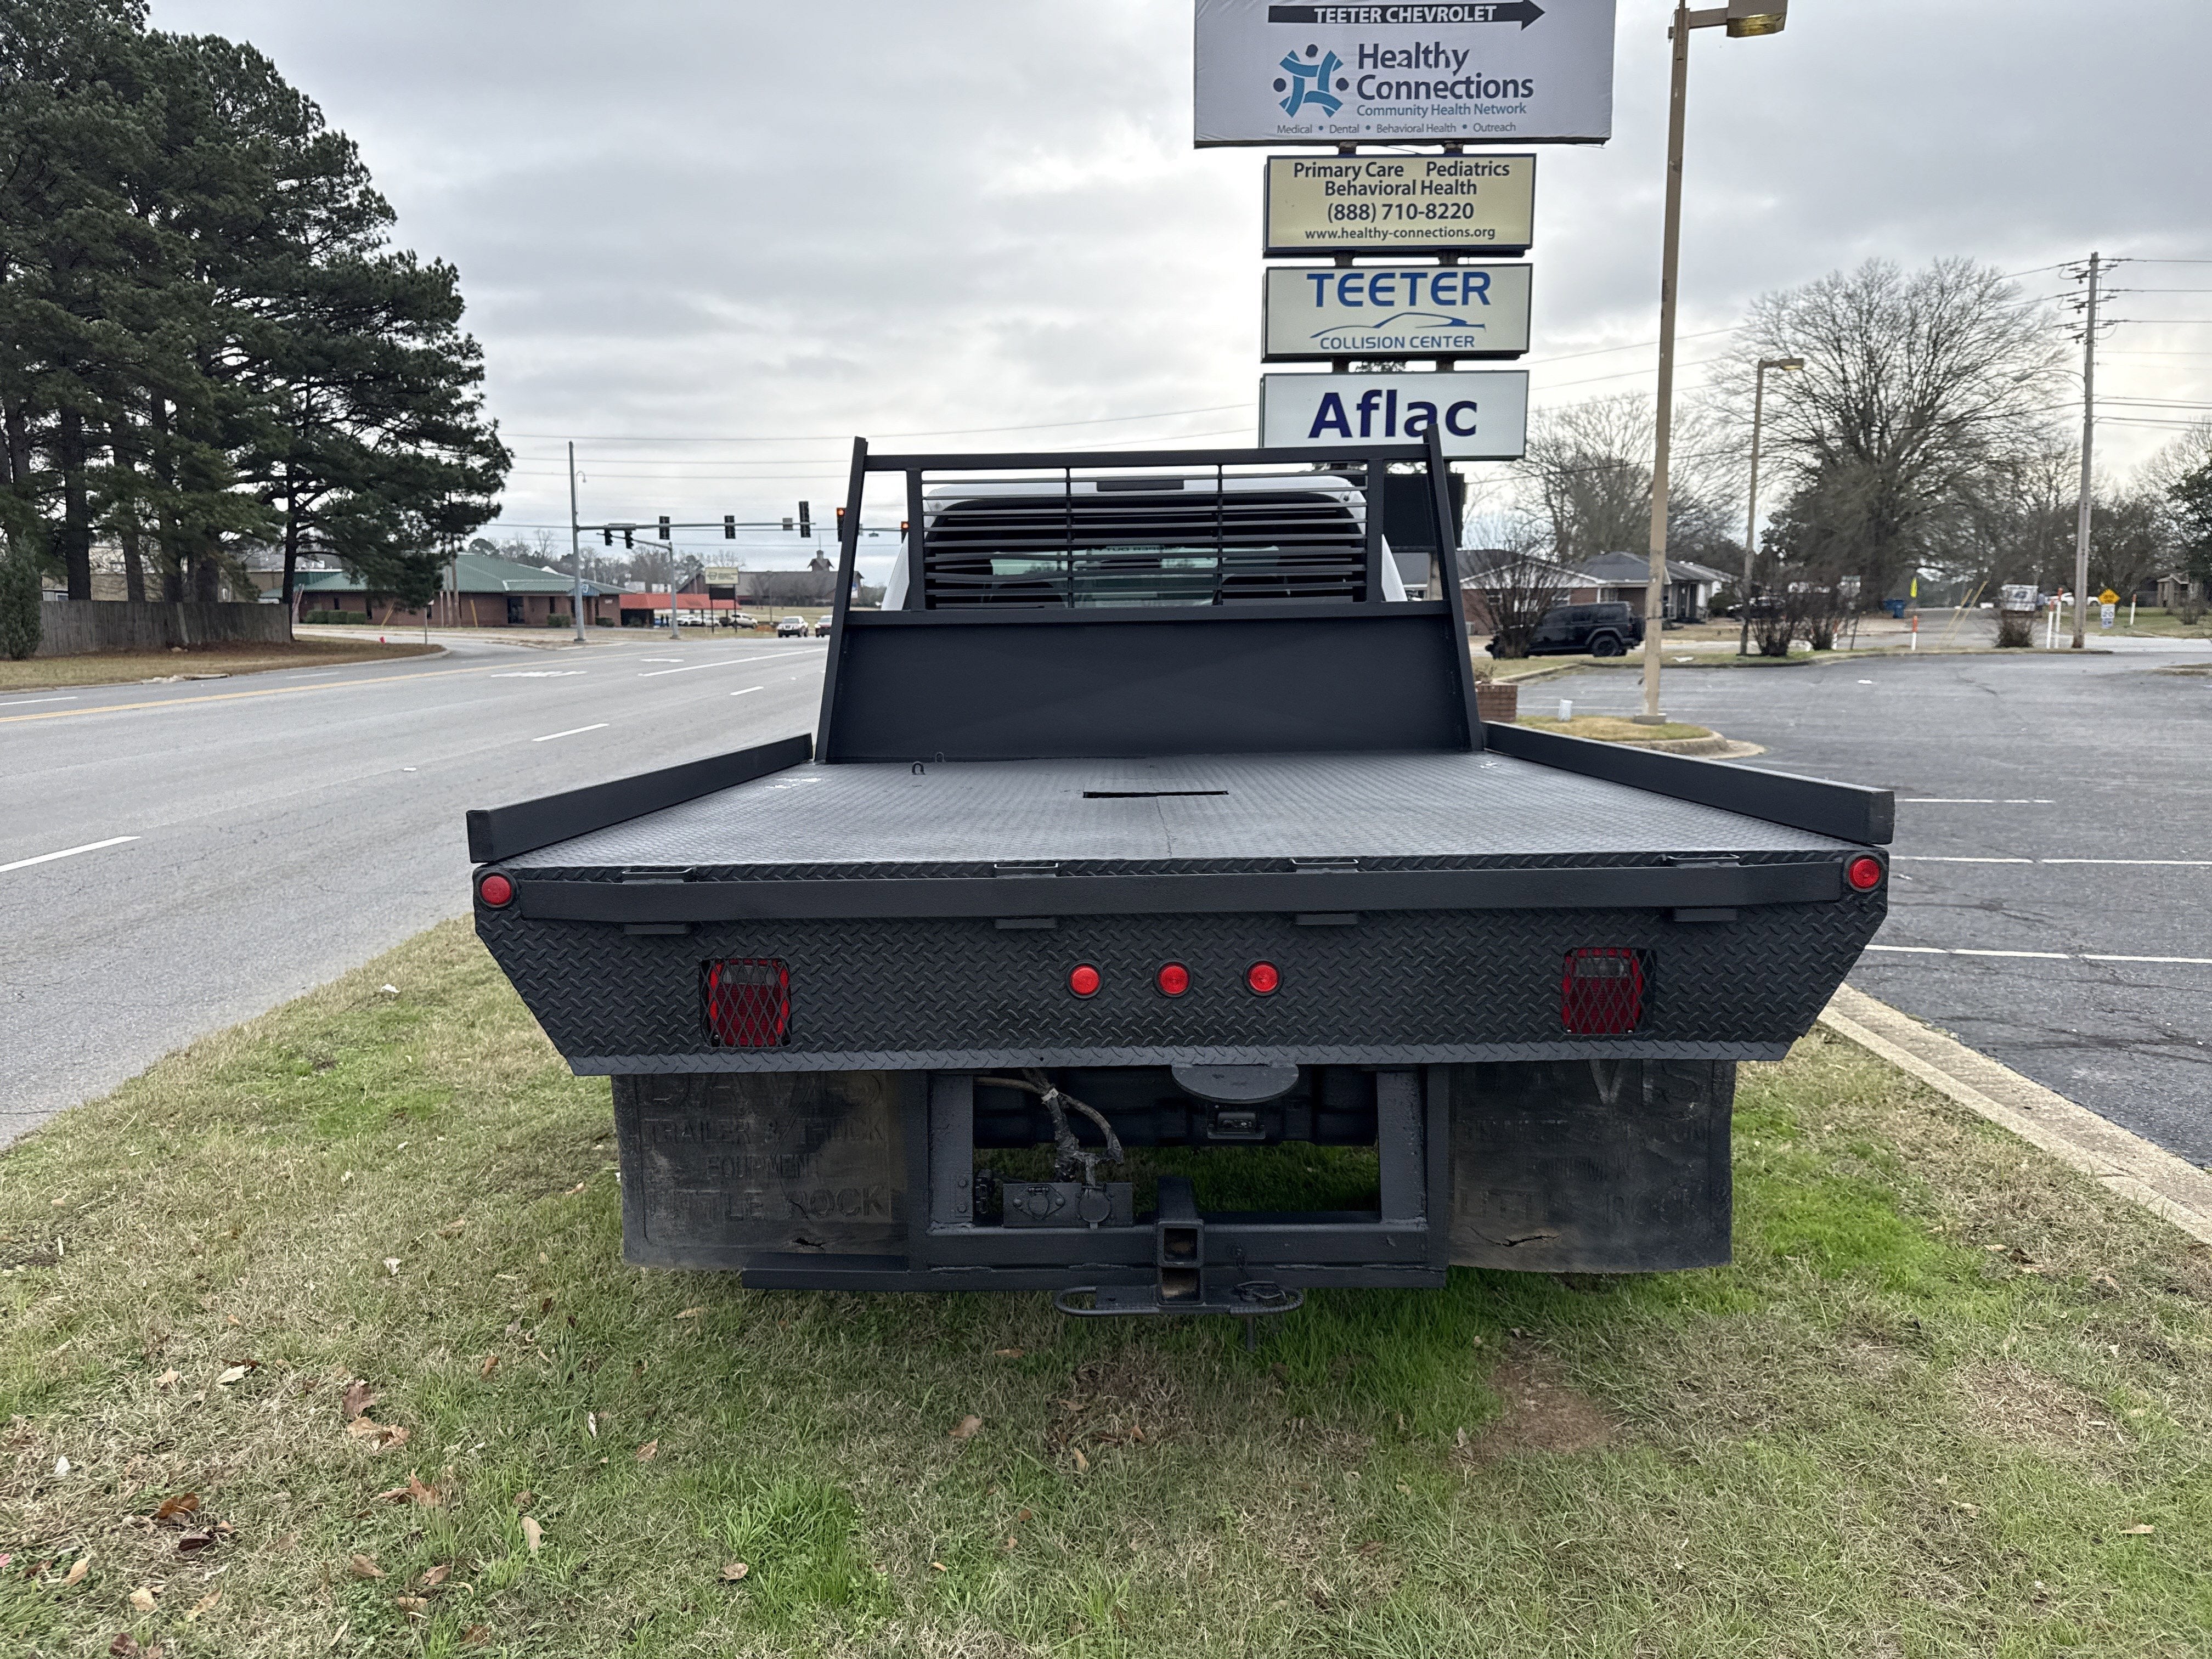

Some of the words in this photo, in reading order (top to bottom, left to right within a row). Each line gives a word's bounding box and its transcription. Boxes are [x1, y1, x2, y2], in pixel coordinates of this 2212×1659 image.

[1313, 7, 1383, 24] TEETER
[1385, 5, 1498, 22] CHEVROLET
[1358, 41, 1470, 75] Healthy
[1357, 71, 1534, 100] Connections
[1356, 104, 1429, 118] Community
[1431, 103, 1471, 116] Health
[1474, 102, 1527, 115] Network
[1277, 124, 1313, 134] Medical
[1329, 123, 1360, 134] Dental
[1376, 123, 1425, 133] Behavioral
[1426, 122, 1457, 133] Health
[1473, 121, 1516, 132] Outreach
[1294, 161, 1362, 181] Primary
[1365, 161, 1404, 177] Care
[1426, 160, 1510, 177] Pediatrics
[1325, 179, 1417, 196] Behavioral
[1420, 179, 1477, 195] Health
[1328, 202, 1376, 224] (888)
[1381, 202, 1475, 221] 710-8220
[1305, 226, 1496, 241] www.healthy-connections.org
[1306, 271, 1491, 308] TEETER
[1319, 336, 1406, 350] COLLISION
[1409, 335, 1475, 348] CENTER
[1308, 389, 1477, 438] Aflac
[787, 1185, 887, 1221] ROCK
